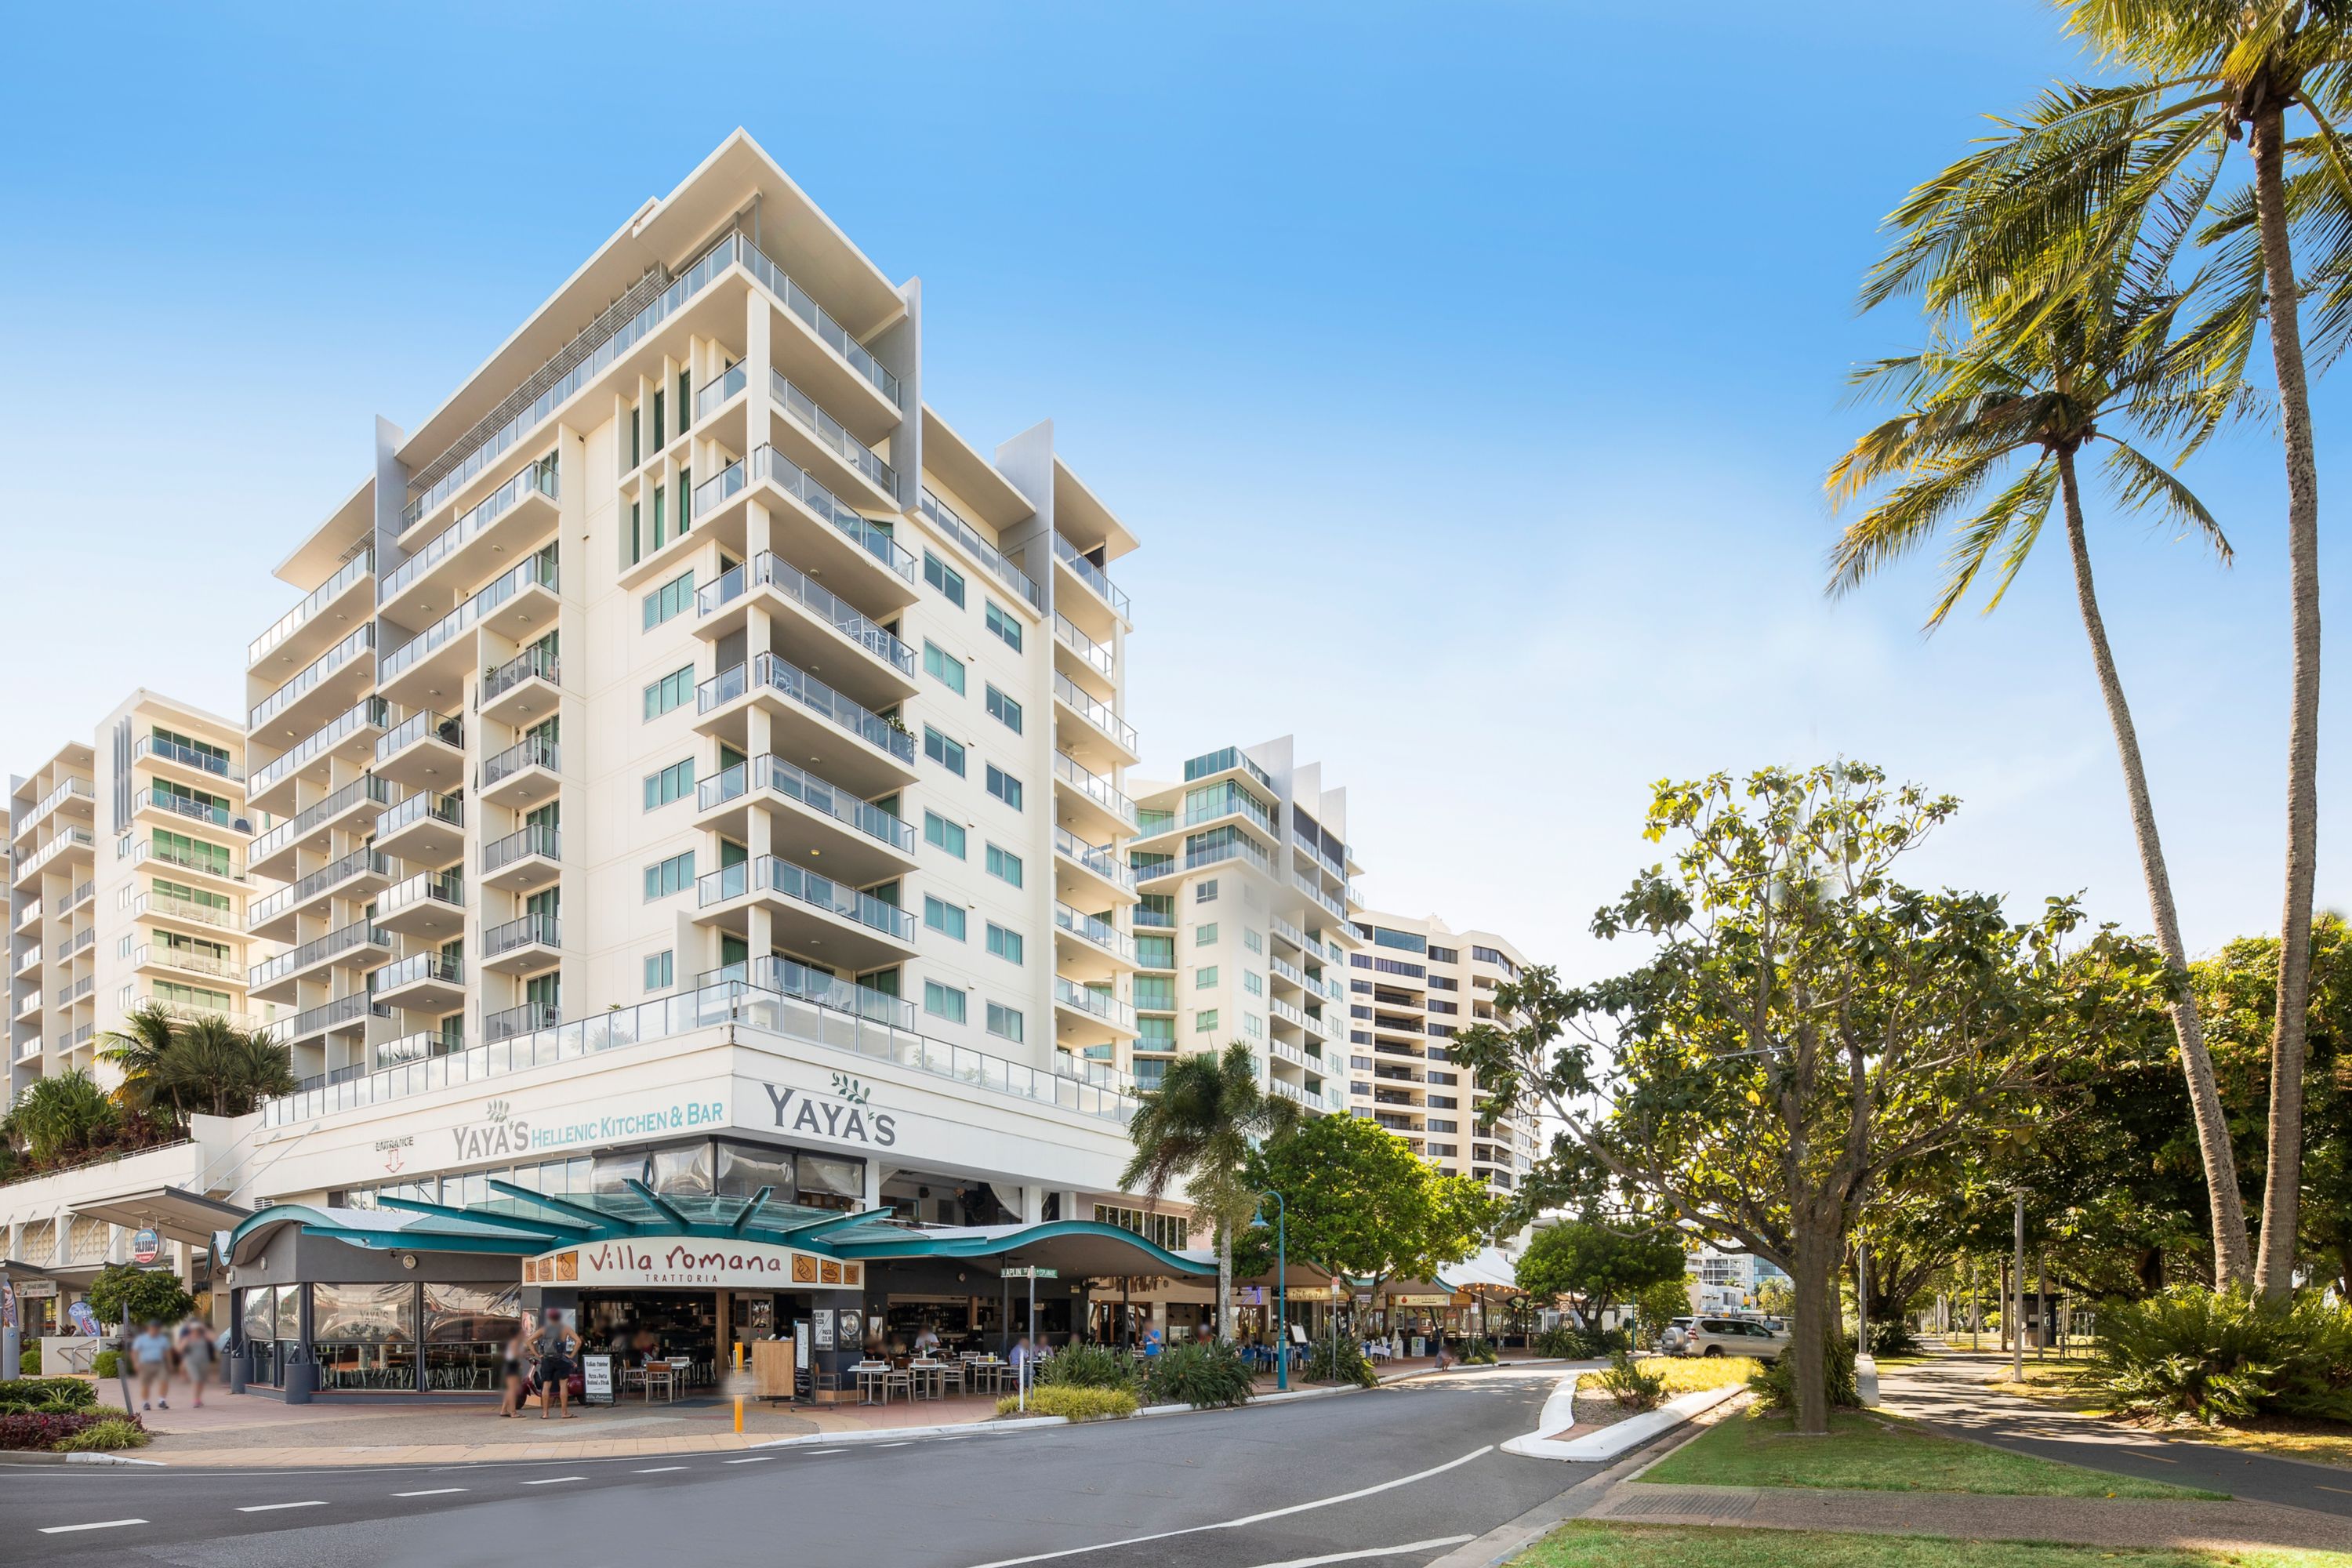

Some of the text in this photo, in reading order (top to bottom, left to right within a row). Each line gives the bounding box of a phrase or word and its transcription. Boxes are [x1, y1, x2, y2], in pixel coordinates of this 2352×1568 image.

[762, 1083, 896, 1146] YAYA'S
[376, 1136, 414, 1152] ENTRANCE
[452, 1102, 723, 1160] YAYA'S HELLENIC KITCHEN & BAR
[589, 1243, 652, 1271] Villa
[645, 1274, 718, 1283] TRATTORIA
